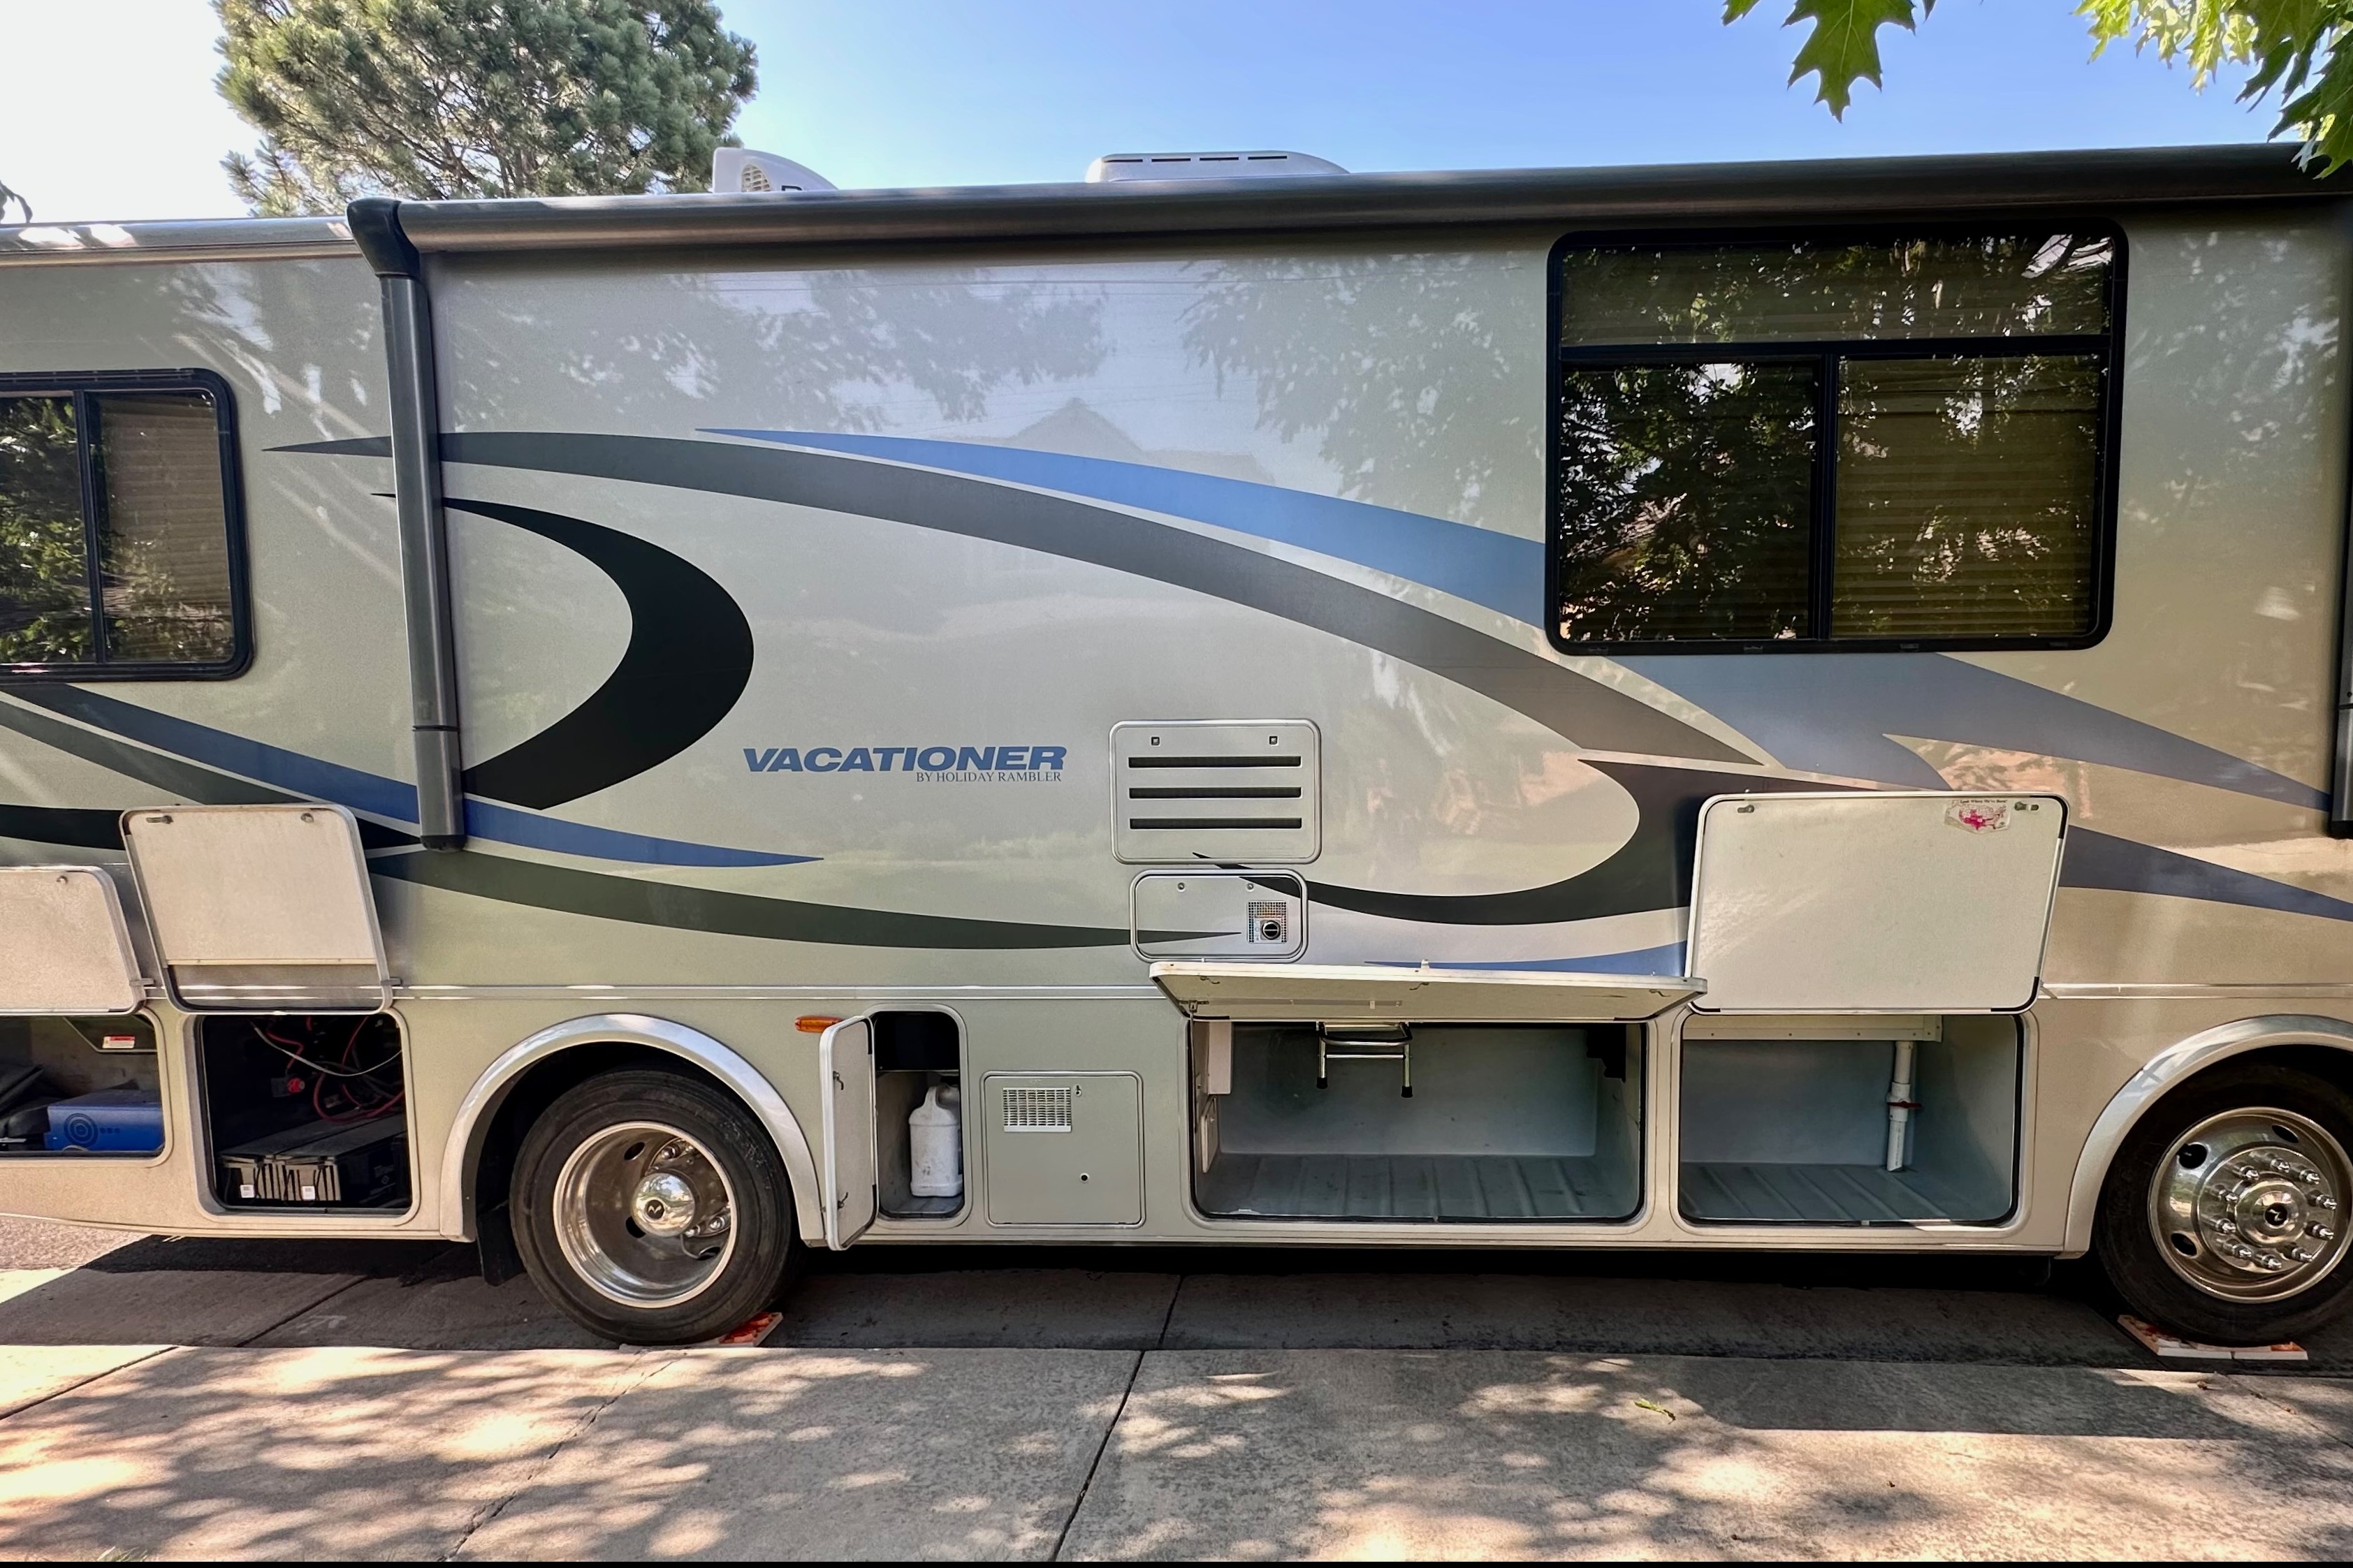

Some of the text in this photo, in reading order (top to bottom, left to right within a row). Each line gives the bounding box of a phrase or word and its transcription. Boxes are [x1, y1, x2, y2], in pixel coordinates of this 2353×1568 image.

[743, 746, 1068, 772] VACATIONER
[917, 771, 1062, 782] BY HOLIDAY RAMBLER
